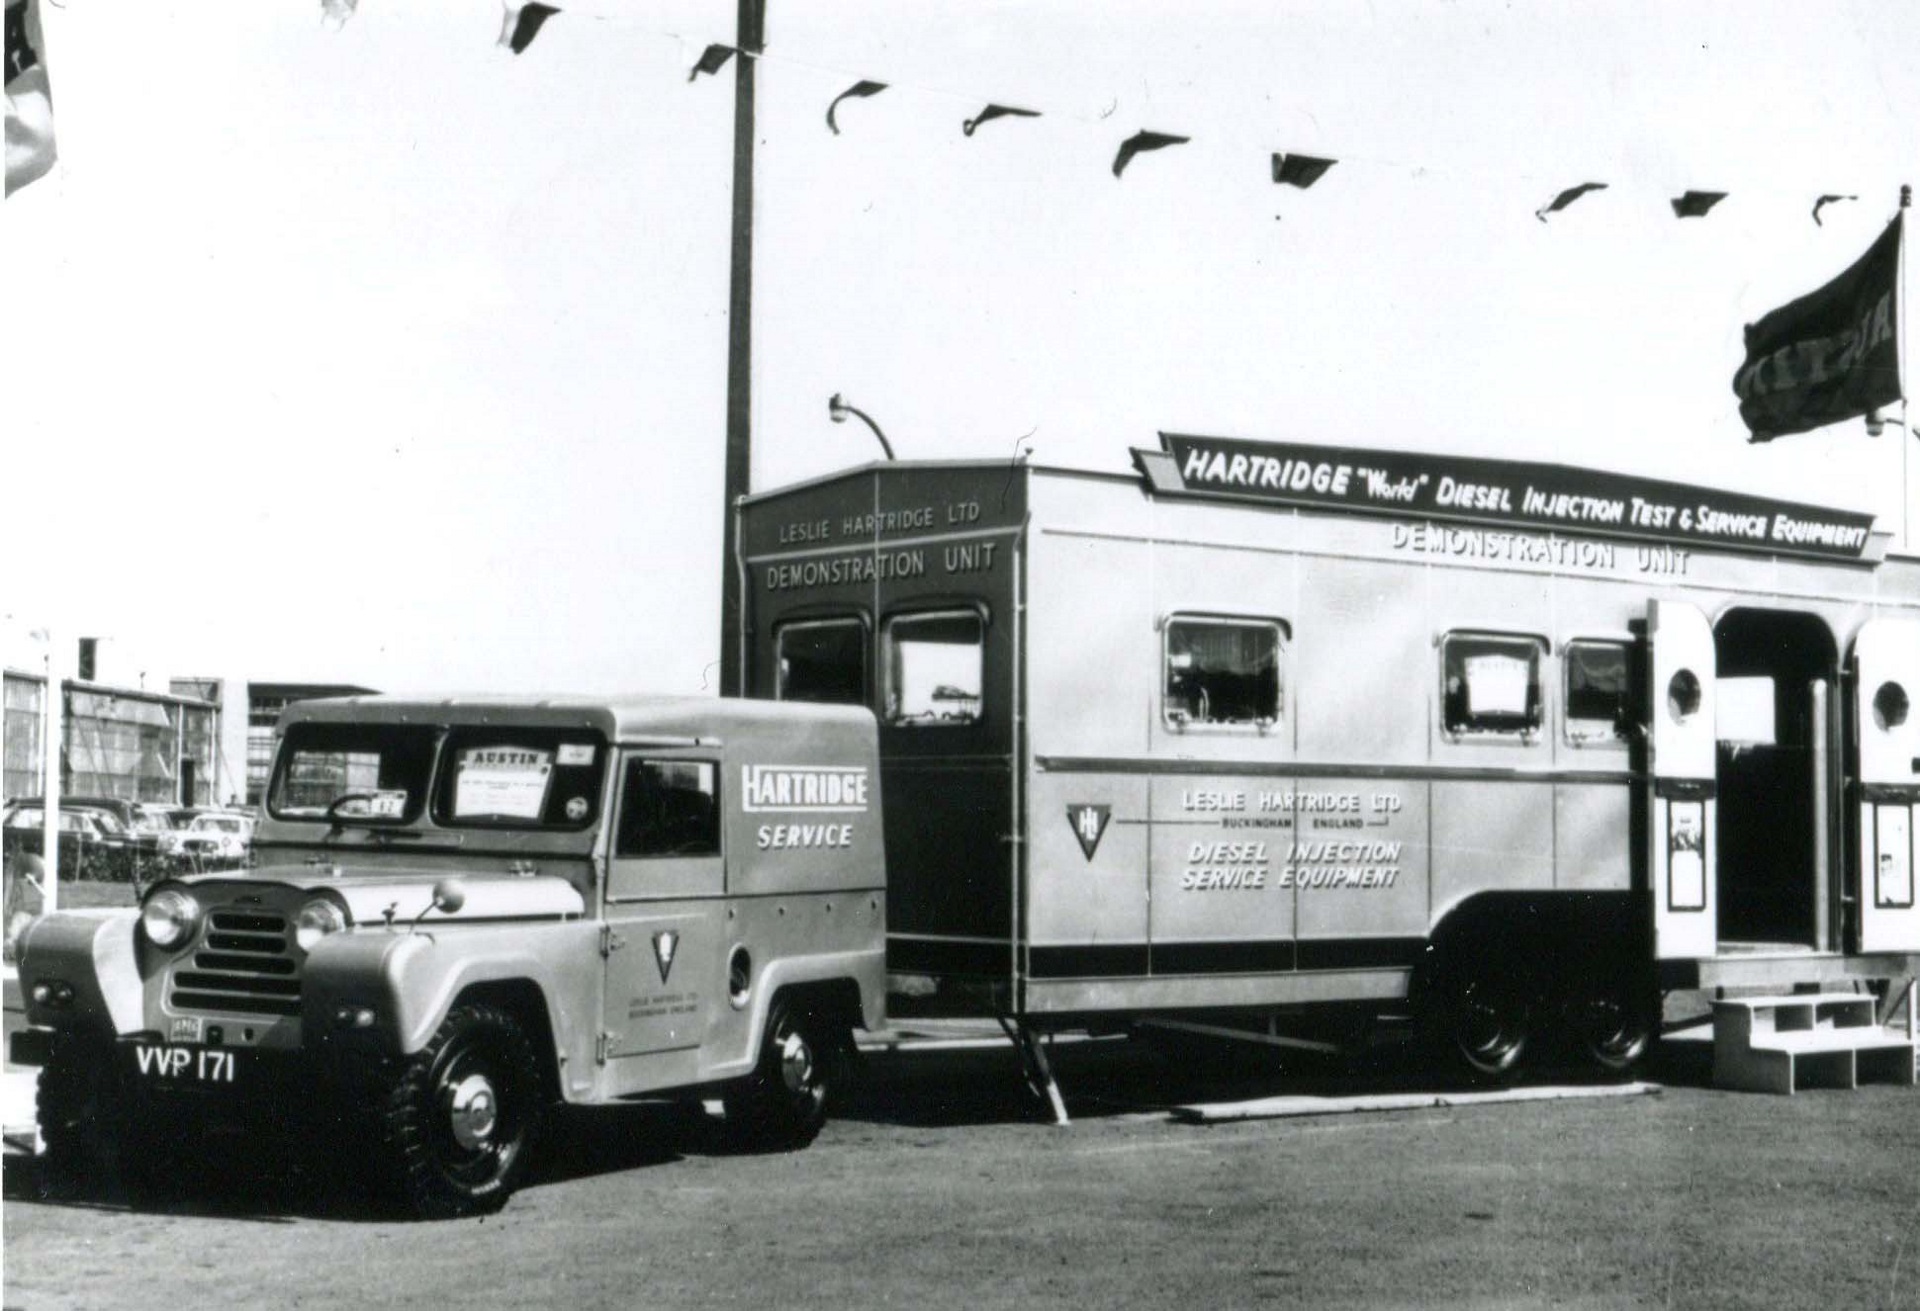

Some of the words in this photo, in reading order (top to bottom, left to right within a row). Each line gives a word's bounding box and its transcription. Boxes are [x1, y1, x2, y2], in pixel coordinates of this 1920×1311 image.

[1184, 448, 1352, 495] HARTRIDGE
[779, 519, 831, 545] LESLIE
[843, 506, 934, 536] HARTRIDGE
[948, 501, 980, 524] LTD
[1391, 524, 1616, 570] DEMONSTRATION
[1636, 545, 1691, 575] UNIT
[766, 550, 926, 590] DEMONSTRATION
[944, 542, 997, 572] UNIT
[474, 751, 540, 766] AUSTIN
[742, 764, 868, 812] HARTRIDGE
[1182, 791, 1246, 812] LESLIE
[1259, 791, 1361, 813] HARTRIDGE
[1371, 793, 1402, 813] LTD
[757, 823, 854, 850] SERVICE
[1222, 817, 1293, 830] BUCKINGHAM
[1312, 818, 1364, 830] ENGLAND
[1187, 841, 1269, 865] DIESEL
[1286, 841, 1402, 865] INJECTION
[1181, 867, 1268, 890] SERVICE
[1278, 867, 1400, 890] EQUIPMENT
[136, 1045, 192, 1077] VVP
[198, 1050, 235, 1082] 171
